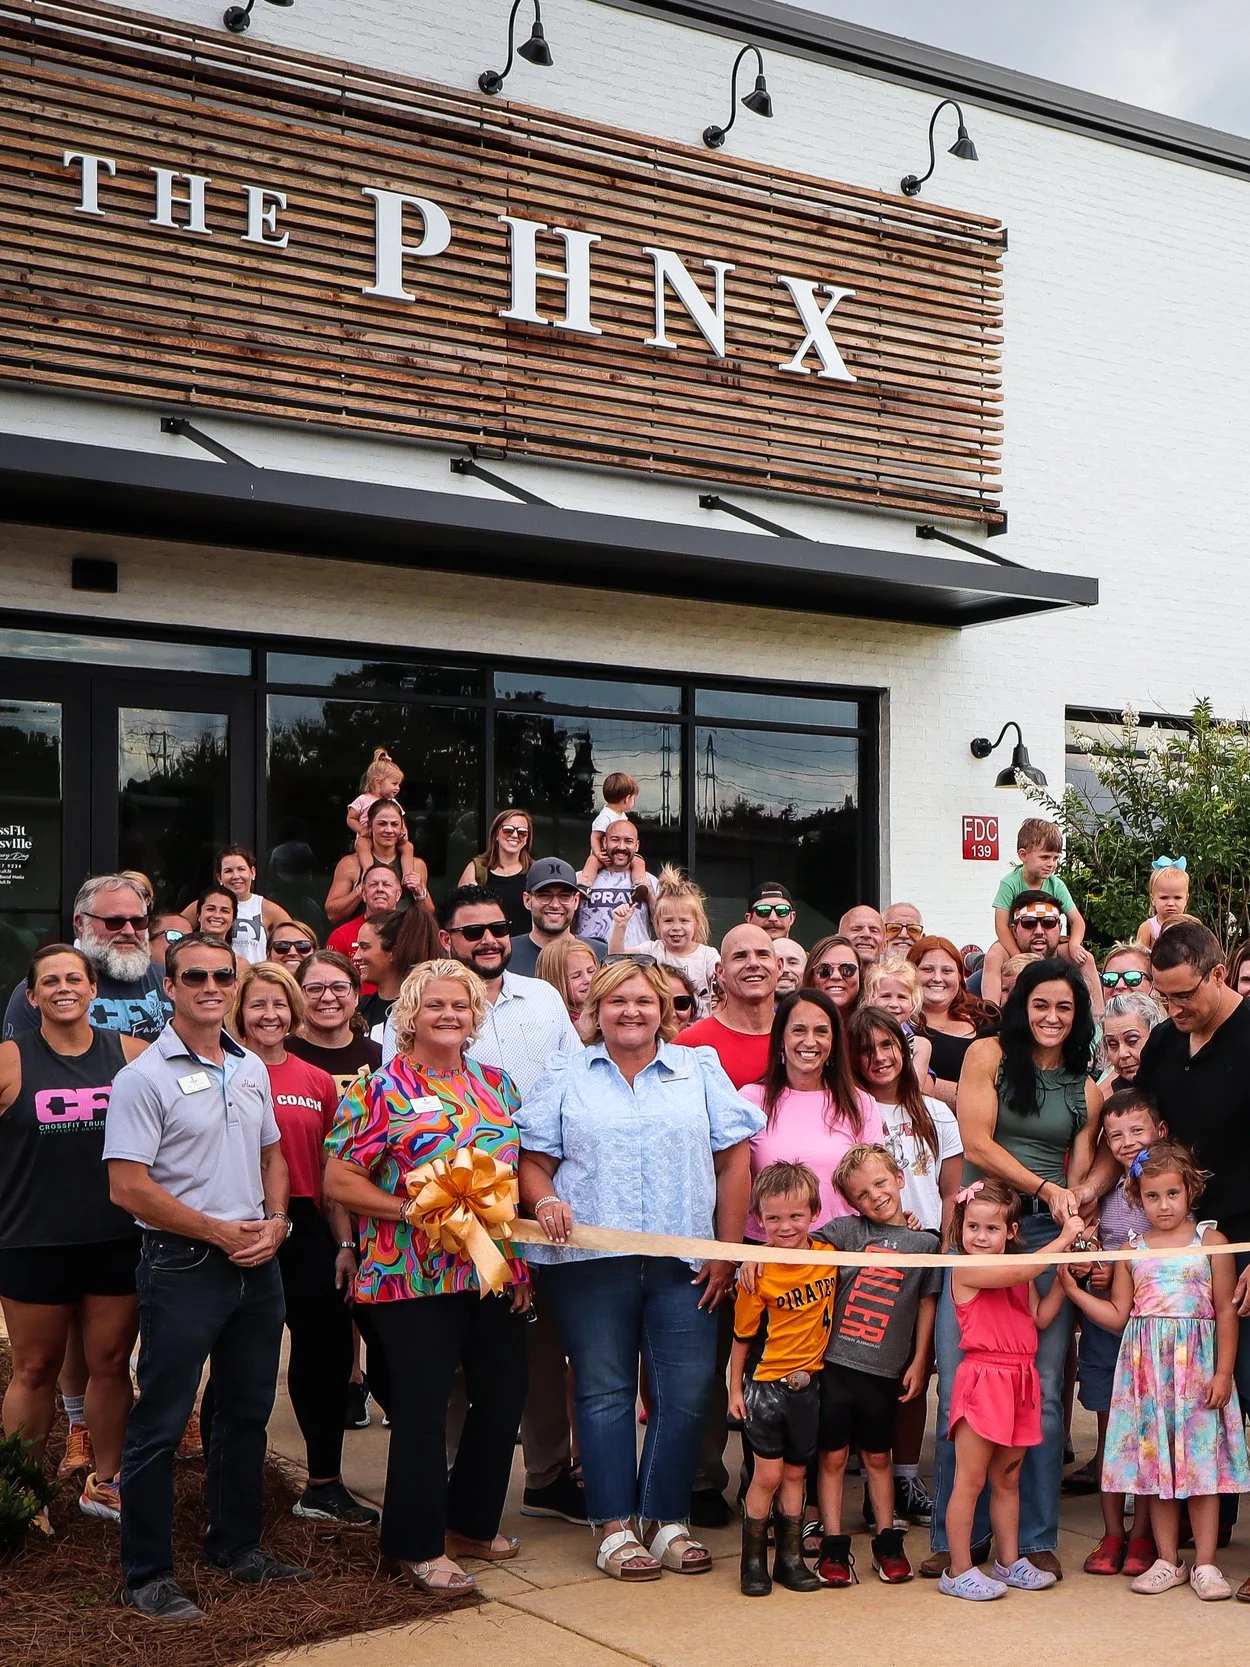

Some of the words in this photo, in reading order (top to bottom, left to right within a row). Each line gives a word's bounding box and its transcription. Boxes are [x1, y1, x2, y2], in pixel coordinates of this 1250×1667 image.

[63, 151, 290, 249] THE
[362, 187, 858, 383] PHNX
[964, 818, 998, 842] FDC
[971, 844, 992, 858] 139
[276, 1095, 322, 1112] COACH
